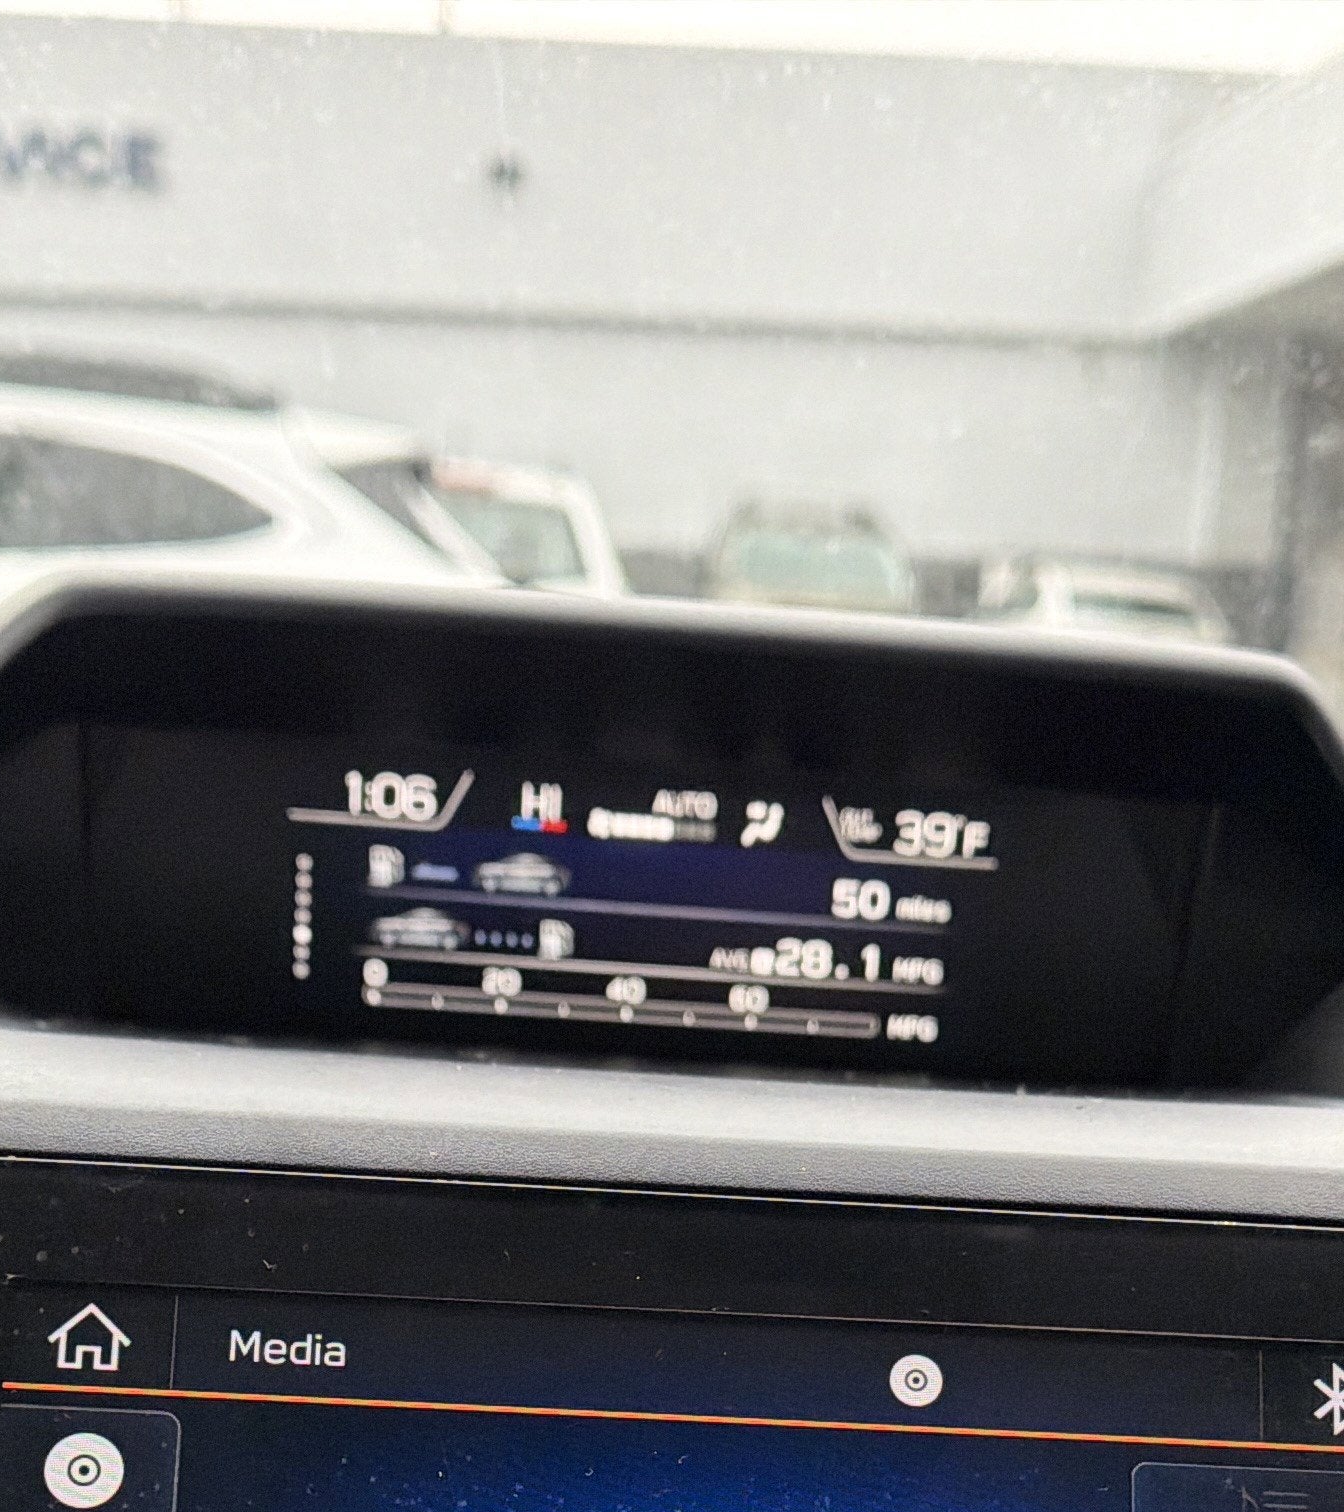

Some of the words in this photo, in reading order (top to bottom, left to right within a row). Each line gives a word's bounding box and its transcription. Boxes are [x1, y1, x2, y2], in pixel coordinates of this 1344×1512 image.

[346, 768, 439, 821] 1:06
[831, 878, 891, 920] 50
[228, 1329, 348, 1369] Media
